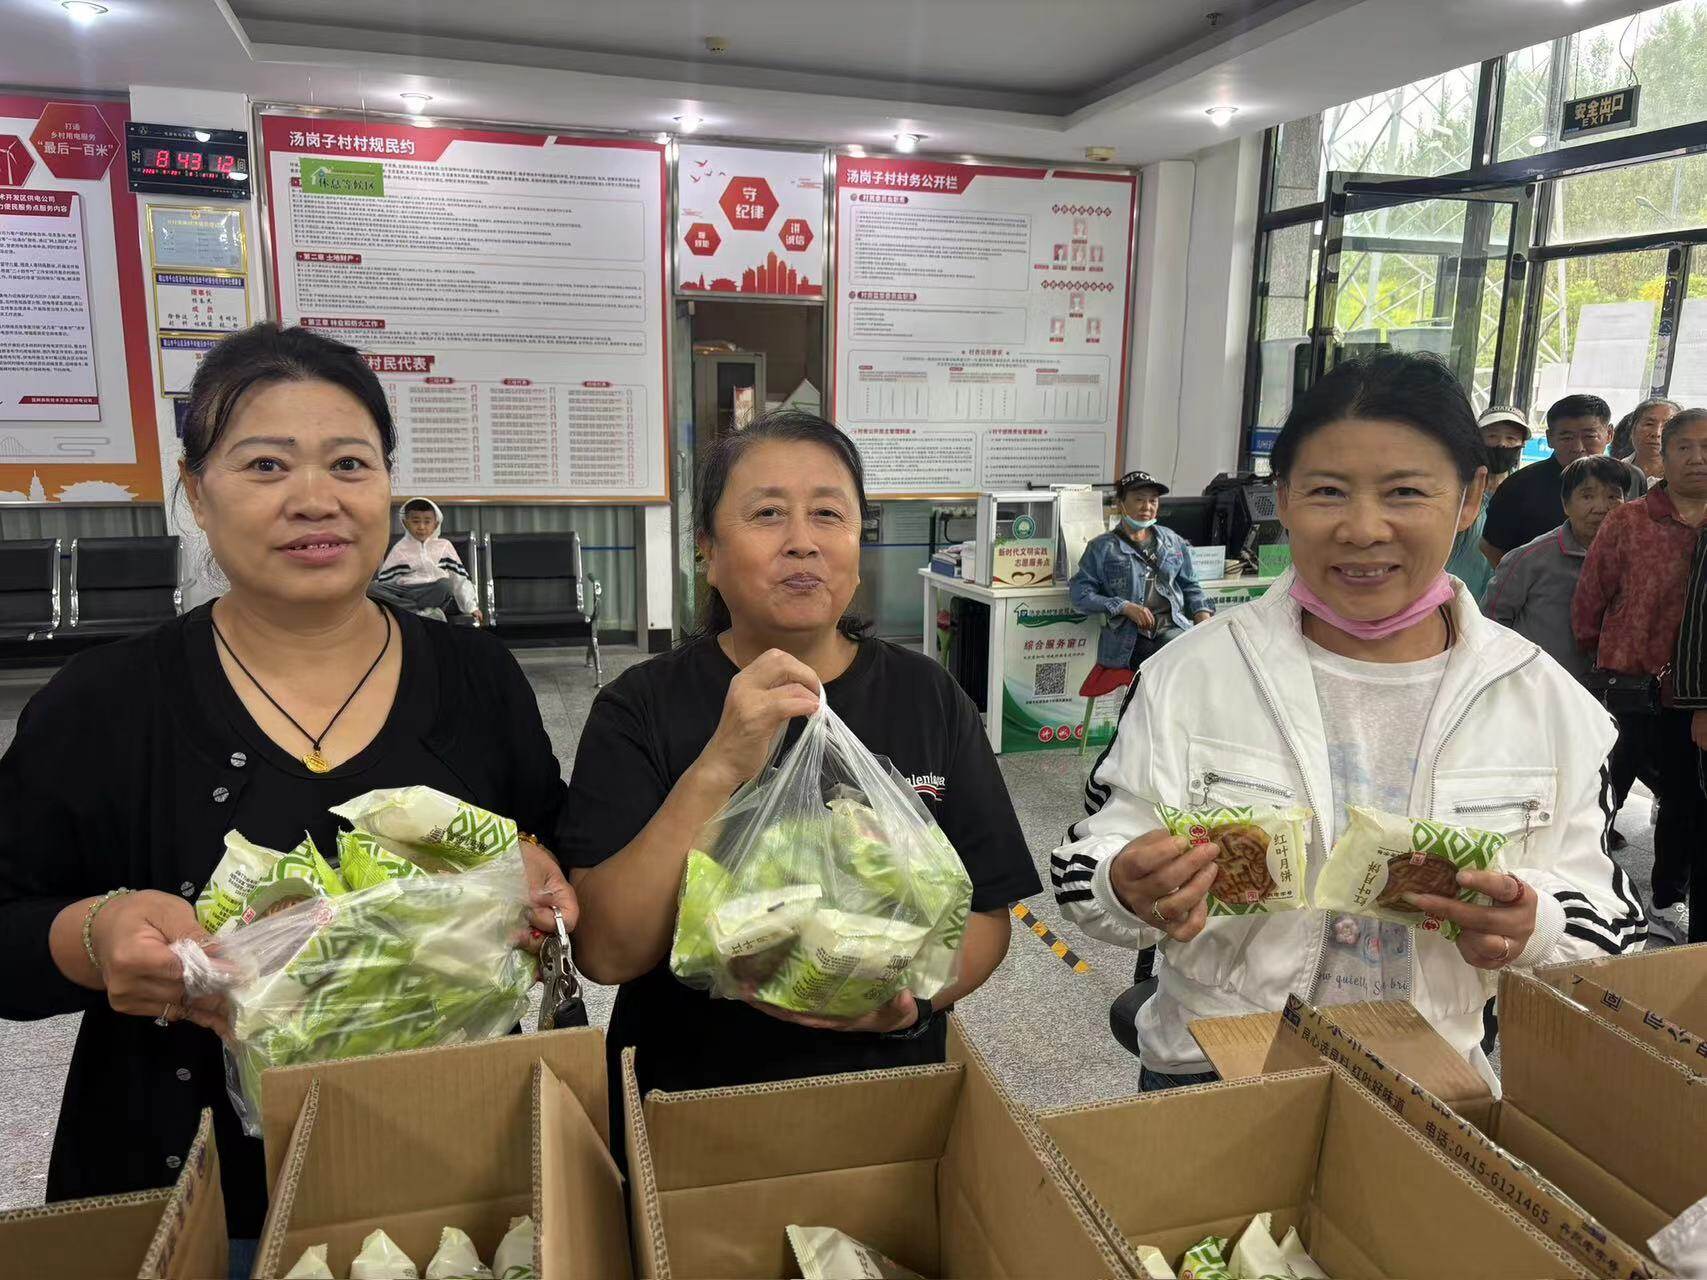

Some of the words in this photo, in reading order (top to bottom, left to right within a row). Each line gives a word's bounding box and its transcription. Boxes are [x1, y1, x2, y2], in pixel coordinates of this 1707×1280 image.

[1574, 94, 1624, 120] 安全出口
[1582, 113, 1613, 127] EXIT
[51, 132, 96, 141] 乡村用电服务
[289, 131, 415, 155] 汤岗子村村规民约
[156, 150, 170, 169] 8
[177, 153, 202, 171] 43
[846, 169, 958, 190] 汤岗子村村务公开栏
[742, 187, 757, 202] 守
[736, 204, 765, 219] 纪律
[368, 356, 427, 371] 村民代表
[998, 547, 1048, 556] 新时代文明实践
[1015, 558, 1050, 567] 志愿服务点
[1024, 638, 1087, 650] 综合服务窗口
[1273, 834, 1293, 883] 红叶月饼
[1353, 861, 1381, 907] 红叶月饼
[1352, 1065, 1406, 1114] 红叶好味道
